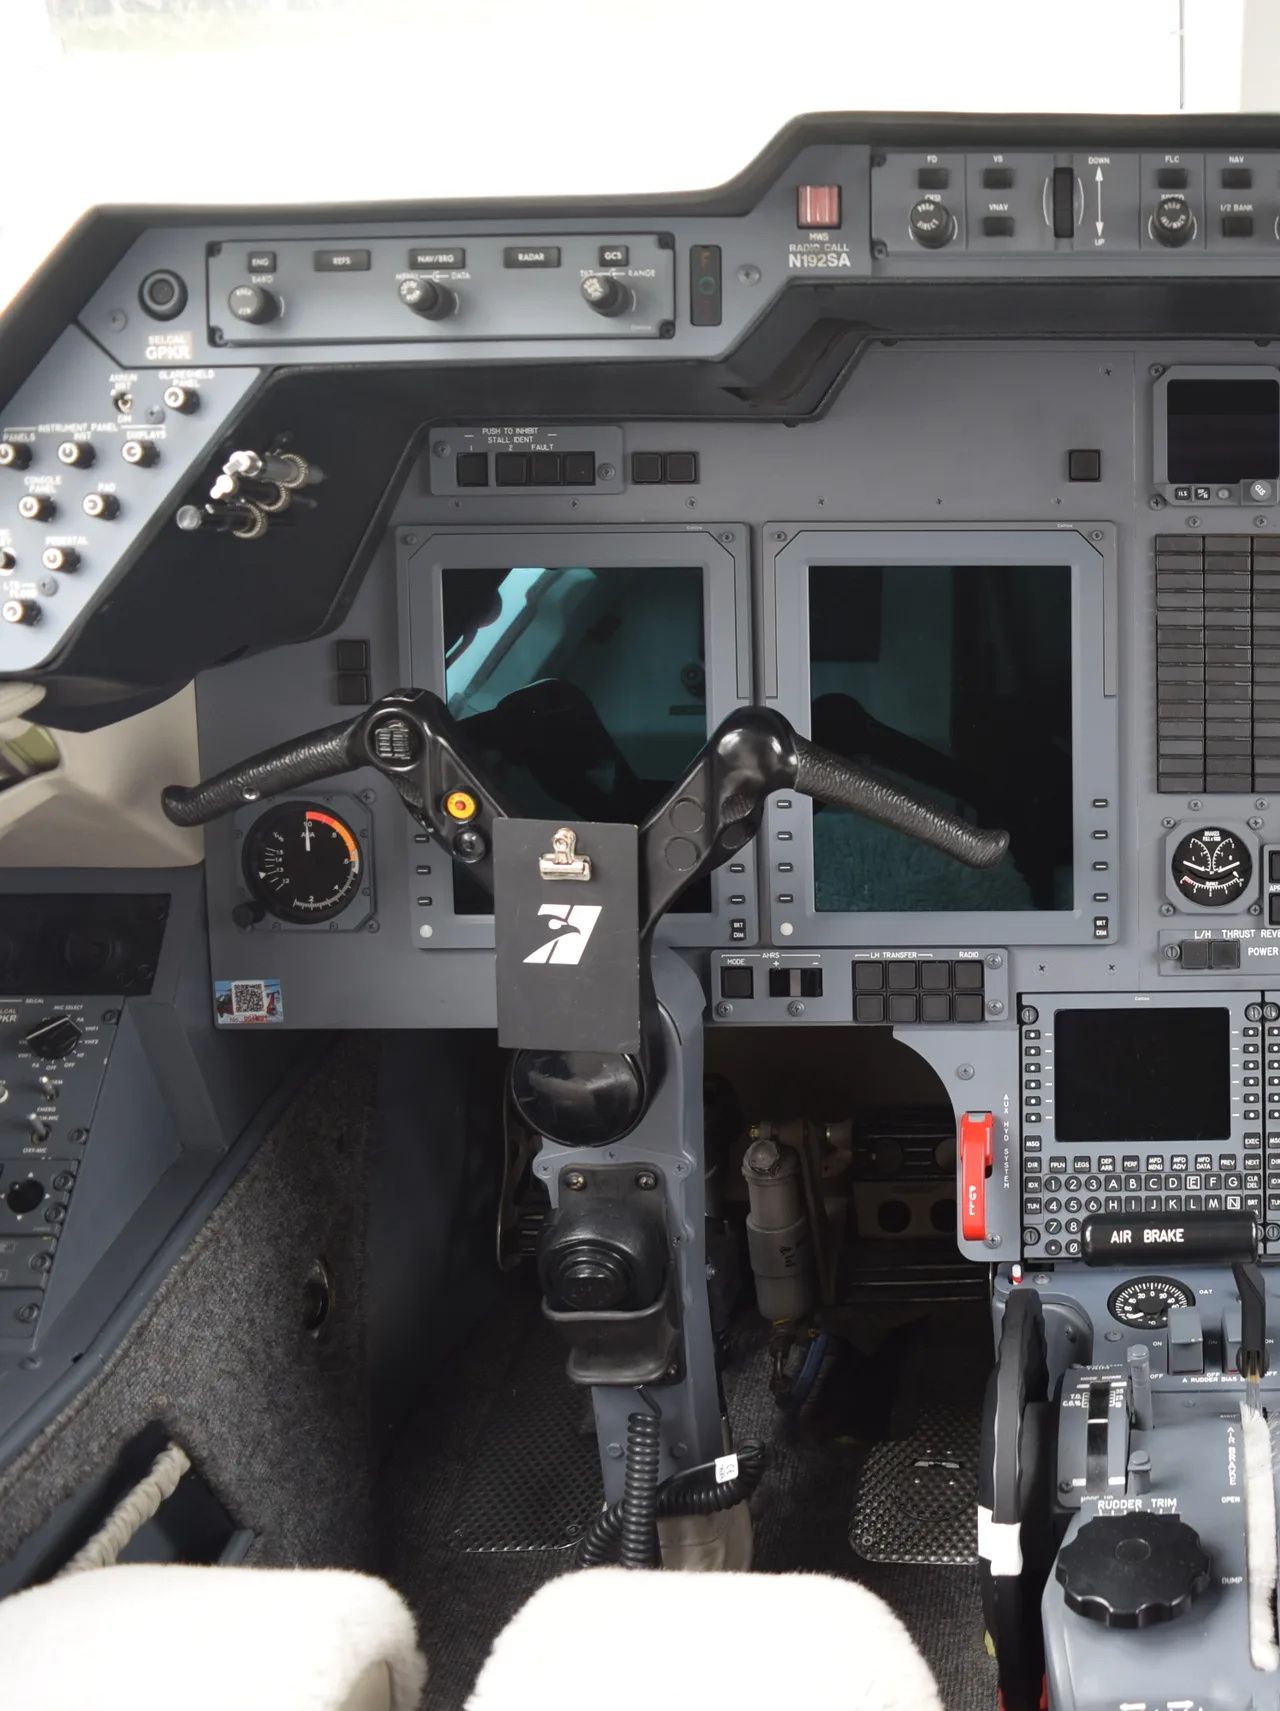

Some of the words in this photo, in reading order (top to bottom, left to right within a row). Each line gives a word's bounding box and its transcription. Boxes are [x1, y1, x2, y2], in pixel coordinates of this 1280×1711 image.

[418, 255, 454, 263] NAV/BRG
[518, 253, 544, 261] RADAR
[605, 252, 622, 260] GCS
[789, 254, 850, 268] N192SA
[146, 347, 190, 359] GPKR
[159, 371, 214, 379] GLARESHIELD
[1194, 931, 1211, 939] L/H
[1111, 1231, 1131, 1242] AIR
[1144, 1229, 1184, 1242] BRAKE
[1098, 1499, 1142, 1510] RUDDER
[1152, 1498, 1176, 1508] TRIM
